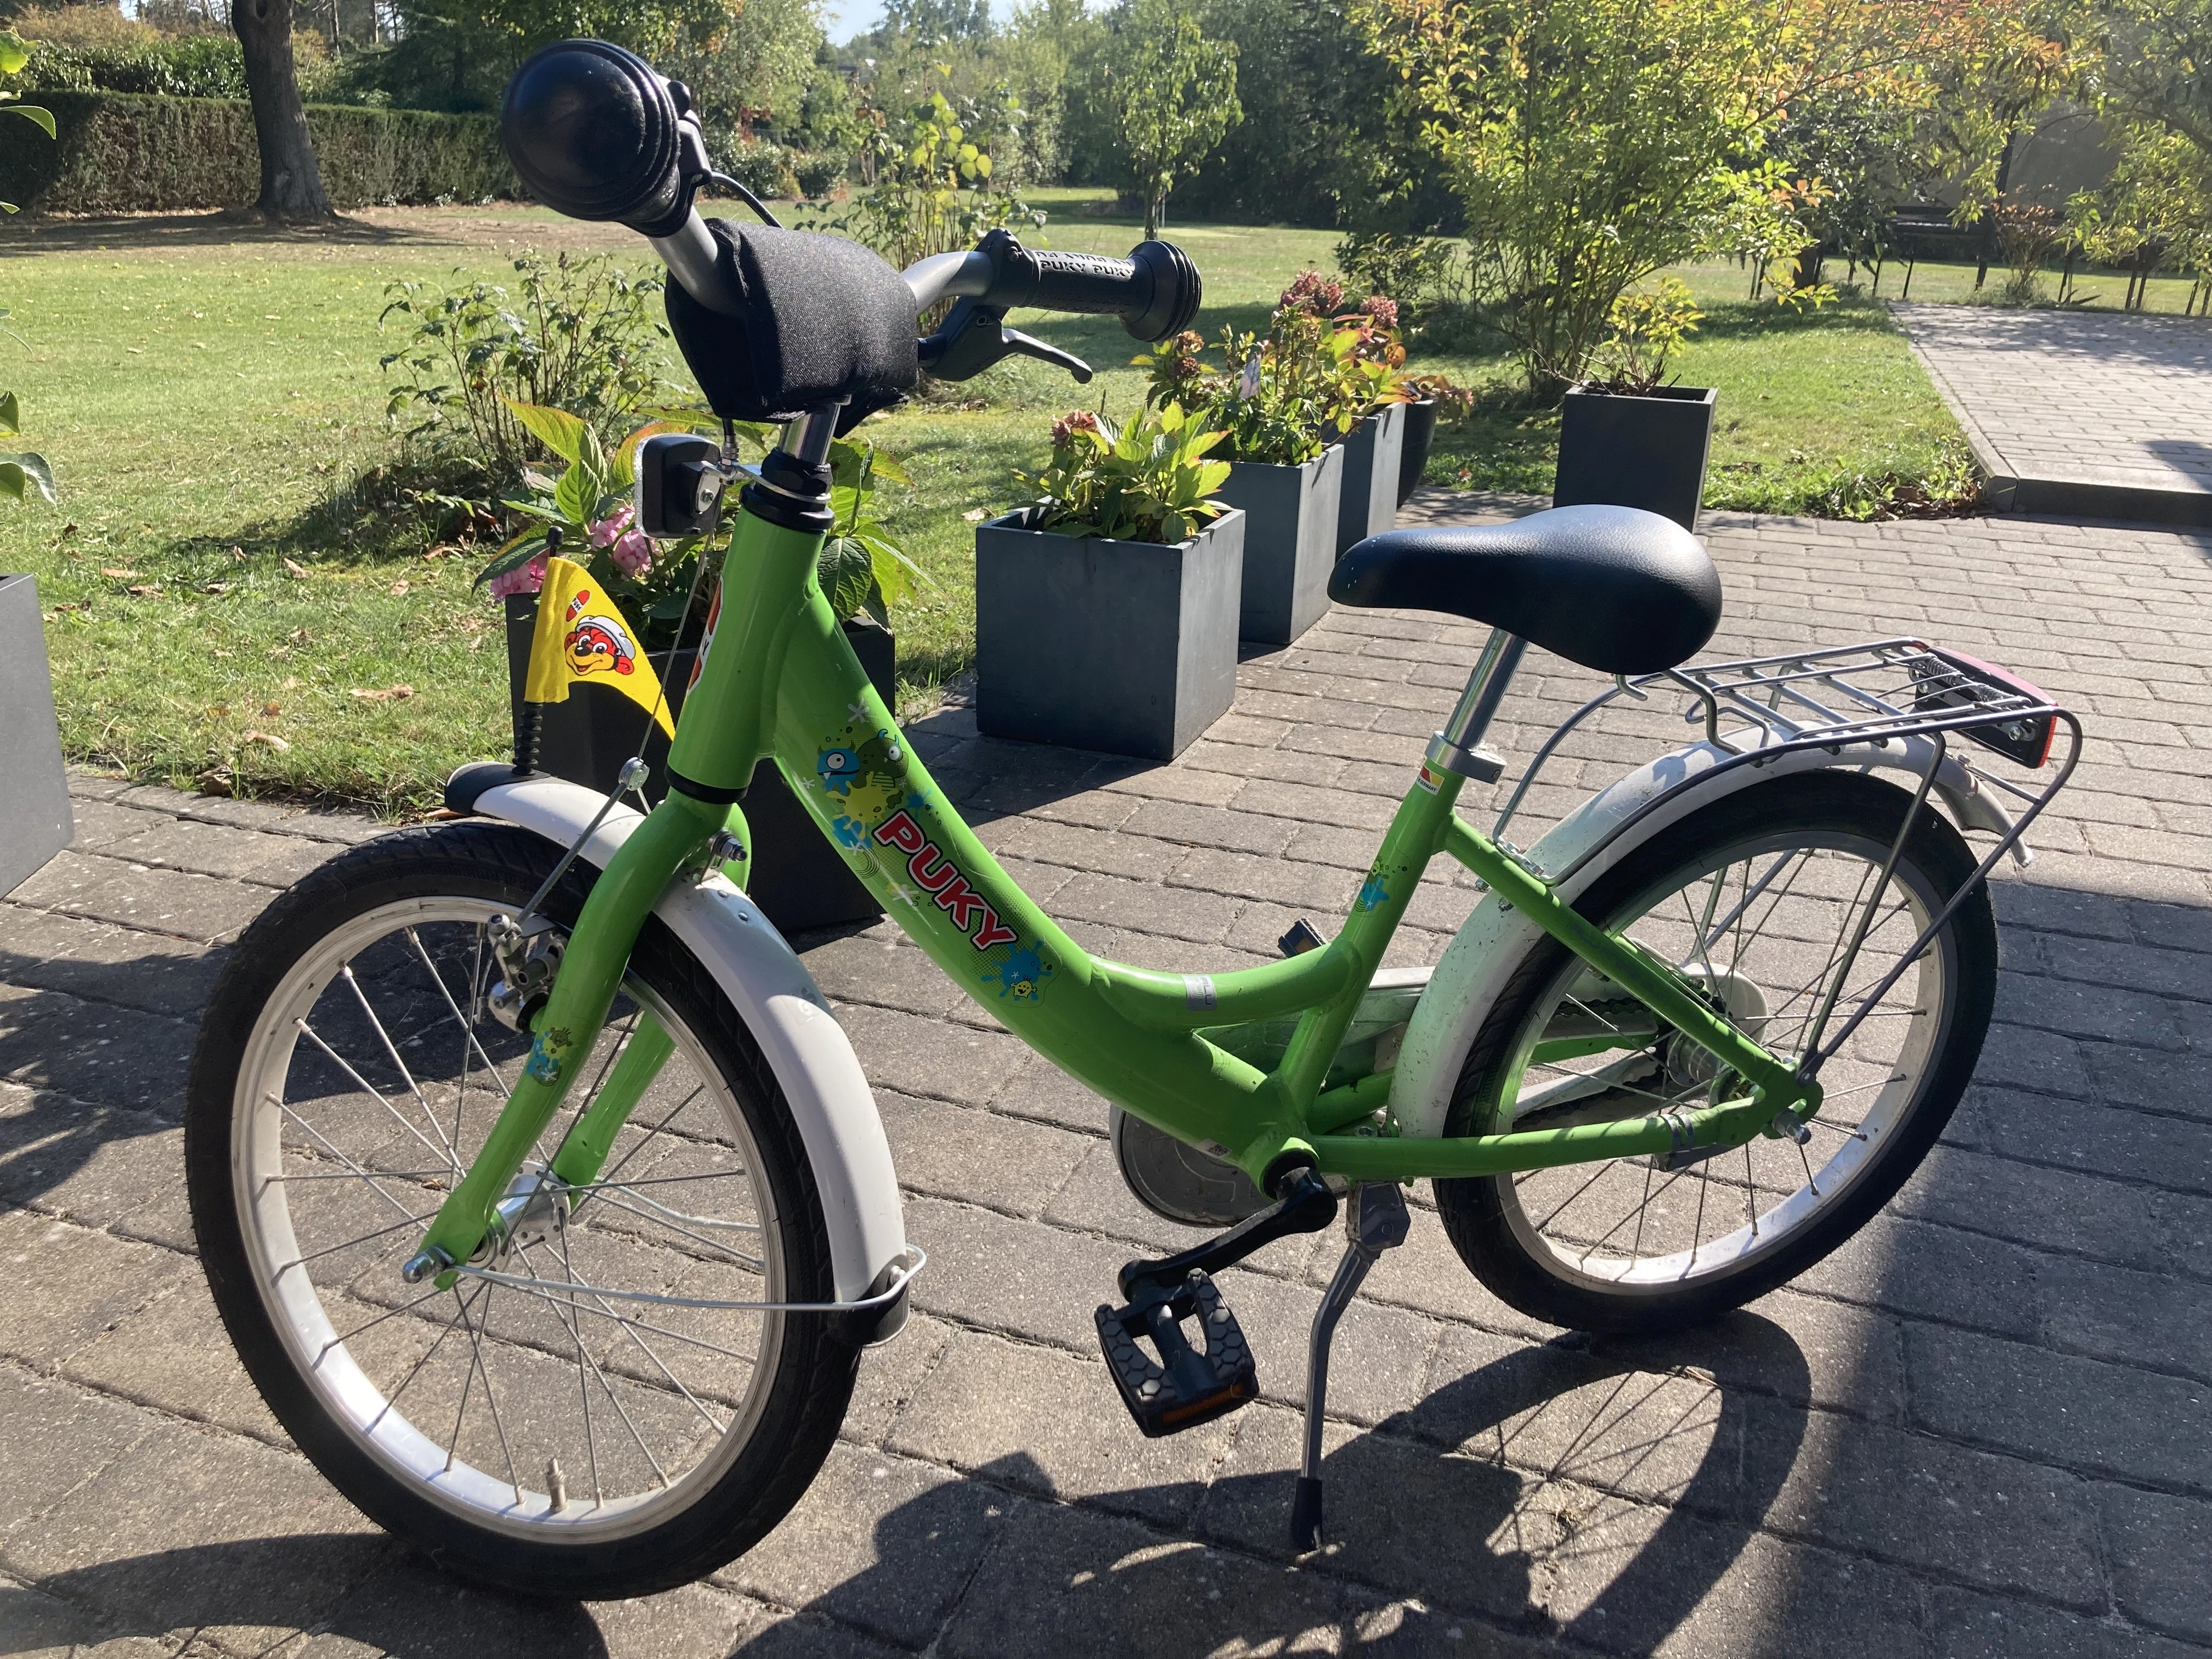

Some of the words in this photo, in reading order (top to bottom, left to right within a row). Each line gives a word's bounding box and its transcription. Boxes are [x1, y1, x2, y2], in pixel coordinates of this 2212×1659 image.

[1039, 259, 1086, 273] PUKY
[1092, 264, 1135, 278] PUKY
[1420, 780, 1437, 792] GERMANY
[873, 808, 1017, 950] PUKY
